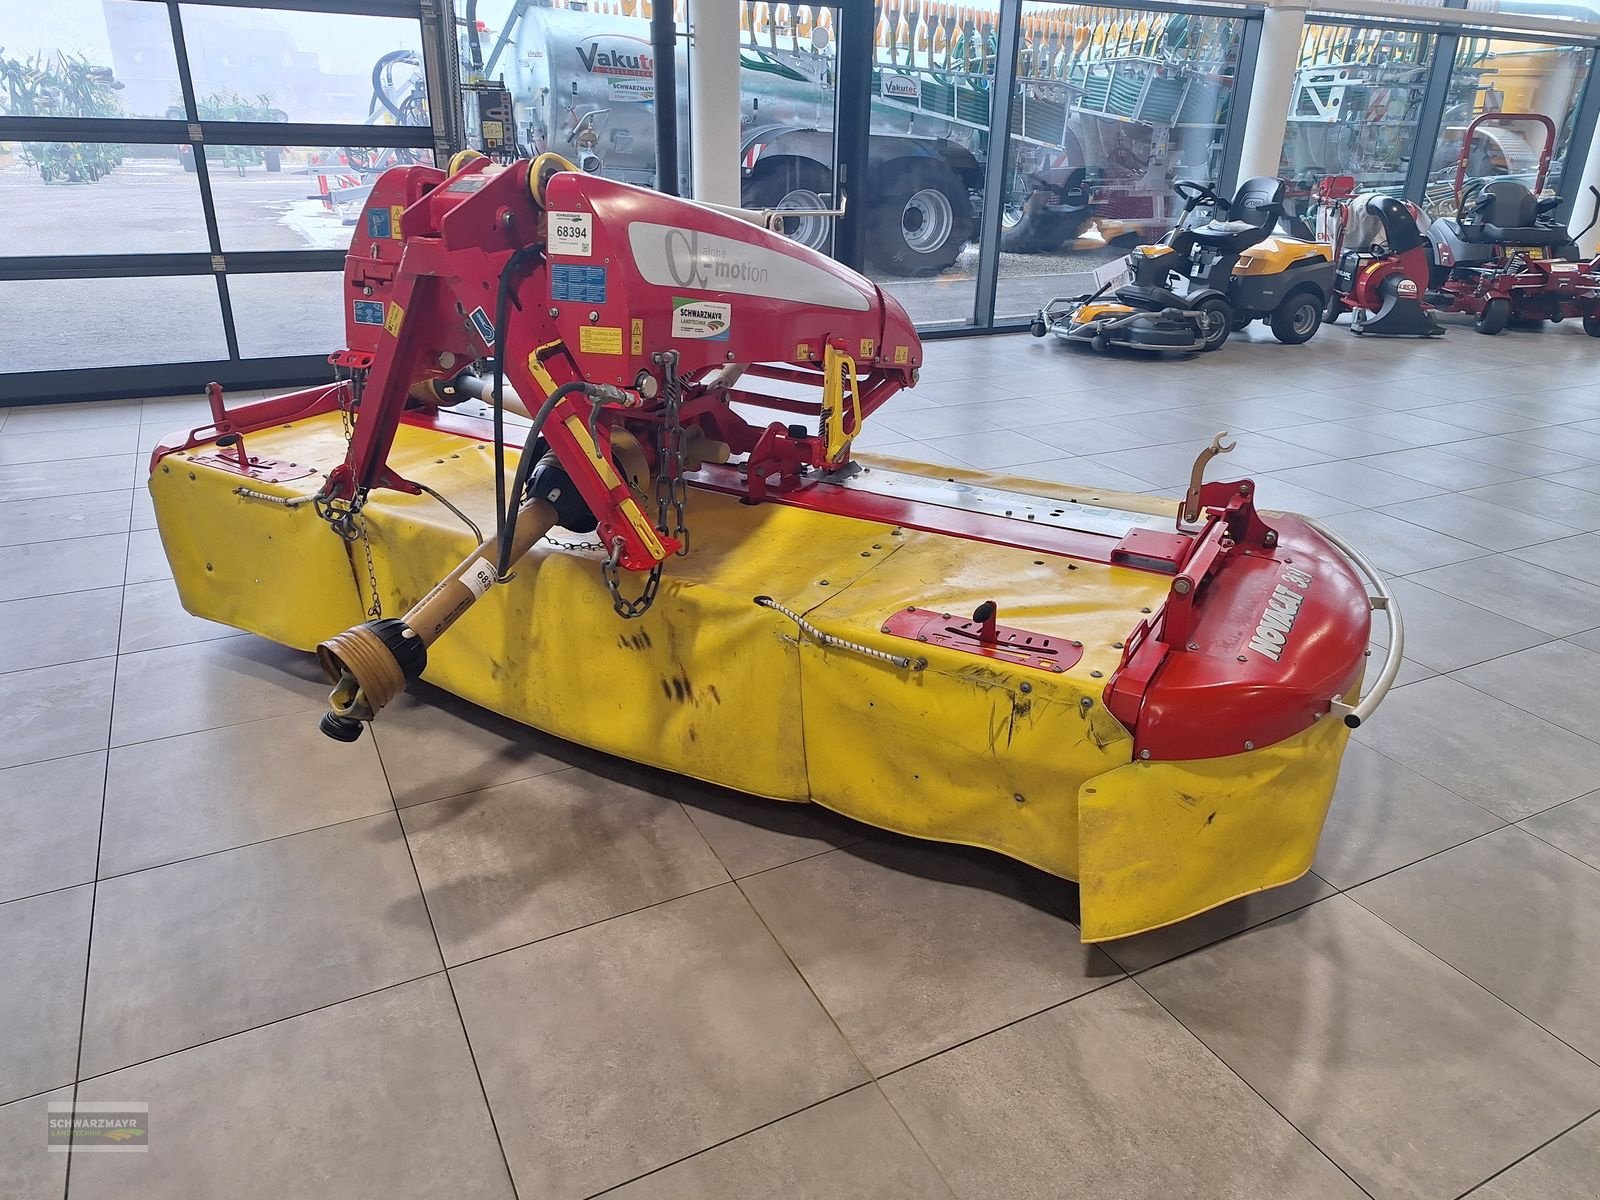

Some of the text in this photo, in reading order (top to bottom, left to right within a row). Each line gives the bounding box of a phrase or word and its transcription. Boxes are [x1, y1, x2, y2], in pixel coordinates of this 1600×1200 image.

[886, 80, 917, 93] Vakutec
[557, 225, 587, 238] 68394
[702, 245, 726, 259] alpha
[680, 308, 722, 320] SCHWARZMAYR
[1248, 584, 1304, 661] NOVACAT
